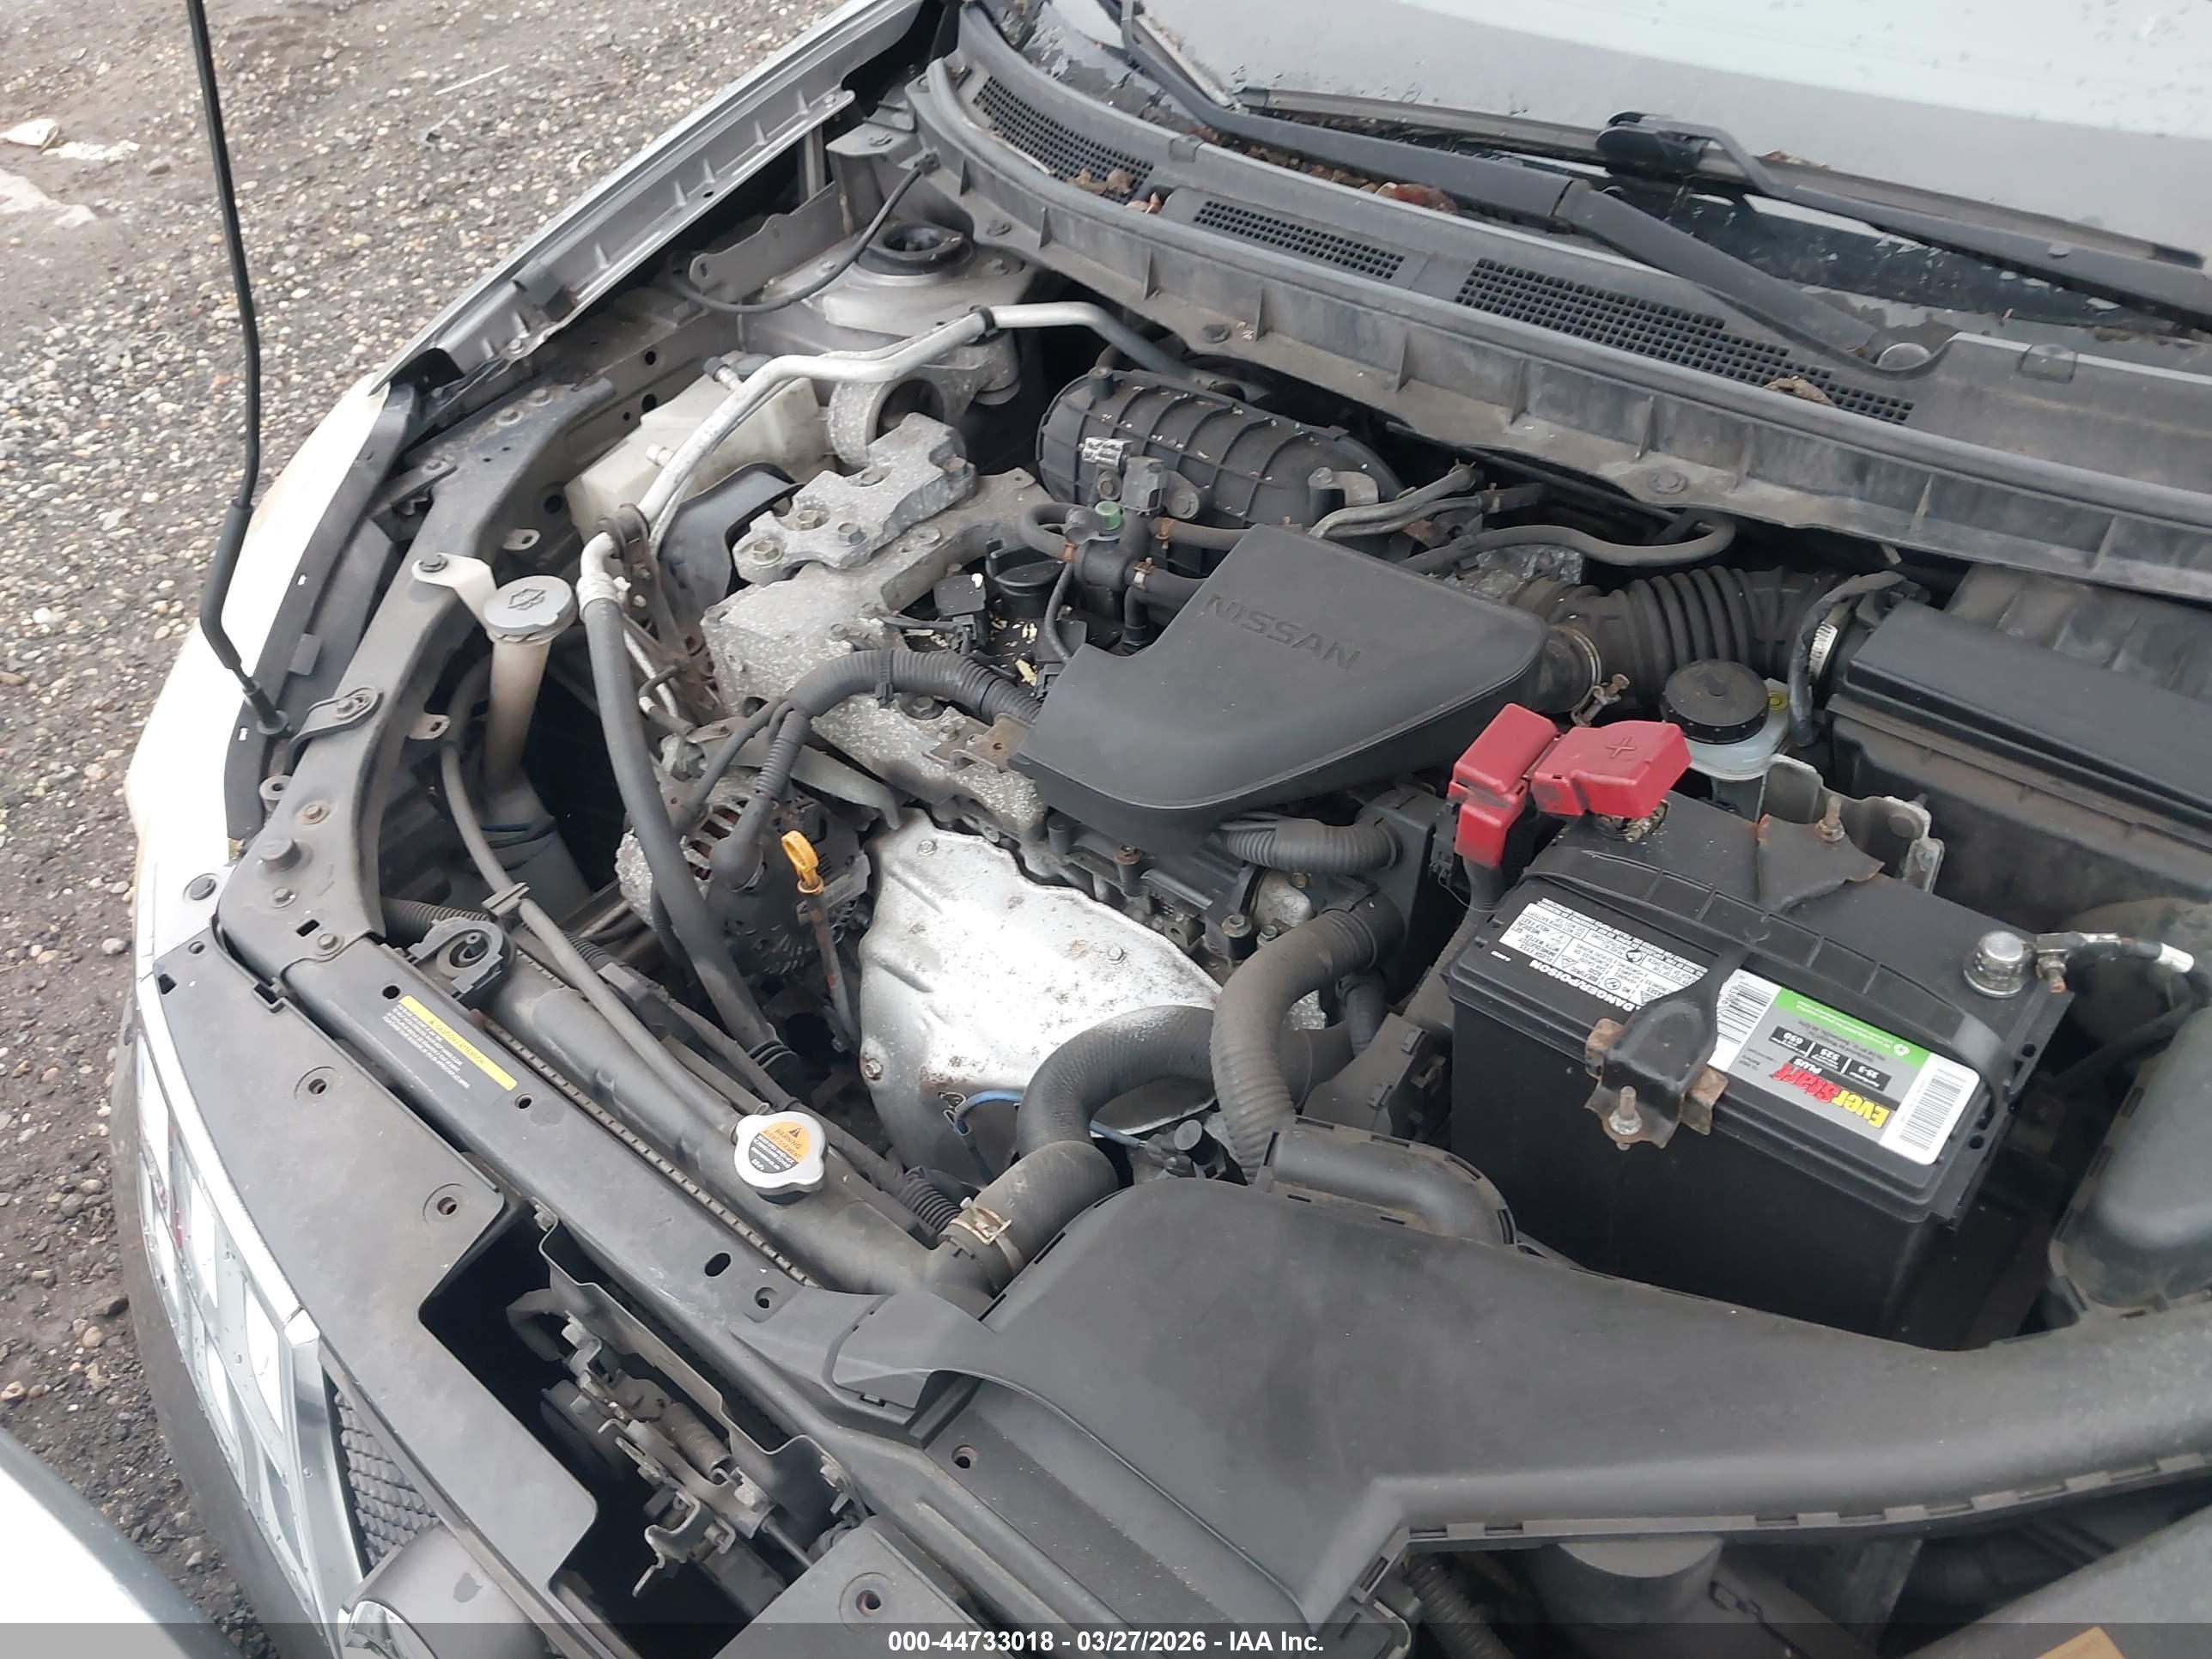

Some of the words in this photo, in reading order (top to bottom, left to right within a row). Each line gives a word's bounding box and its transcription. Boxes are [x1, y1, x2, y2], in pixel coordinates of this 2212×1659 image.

[1204, 593, 1362, 671] NISSAN
[1528, 957, 1636, 1012] DANGER/POISON
[1782, 1030, 1804, 1045] 650
[1819, 1046, 1841, 1061] 525
[1792, 1056, 1823, 1075] PLUS
[1770, 1062, 1892, 1128] EverStart
[774, 1128, 803, 1150] WARNING
